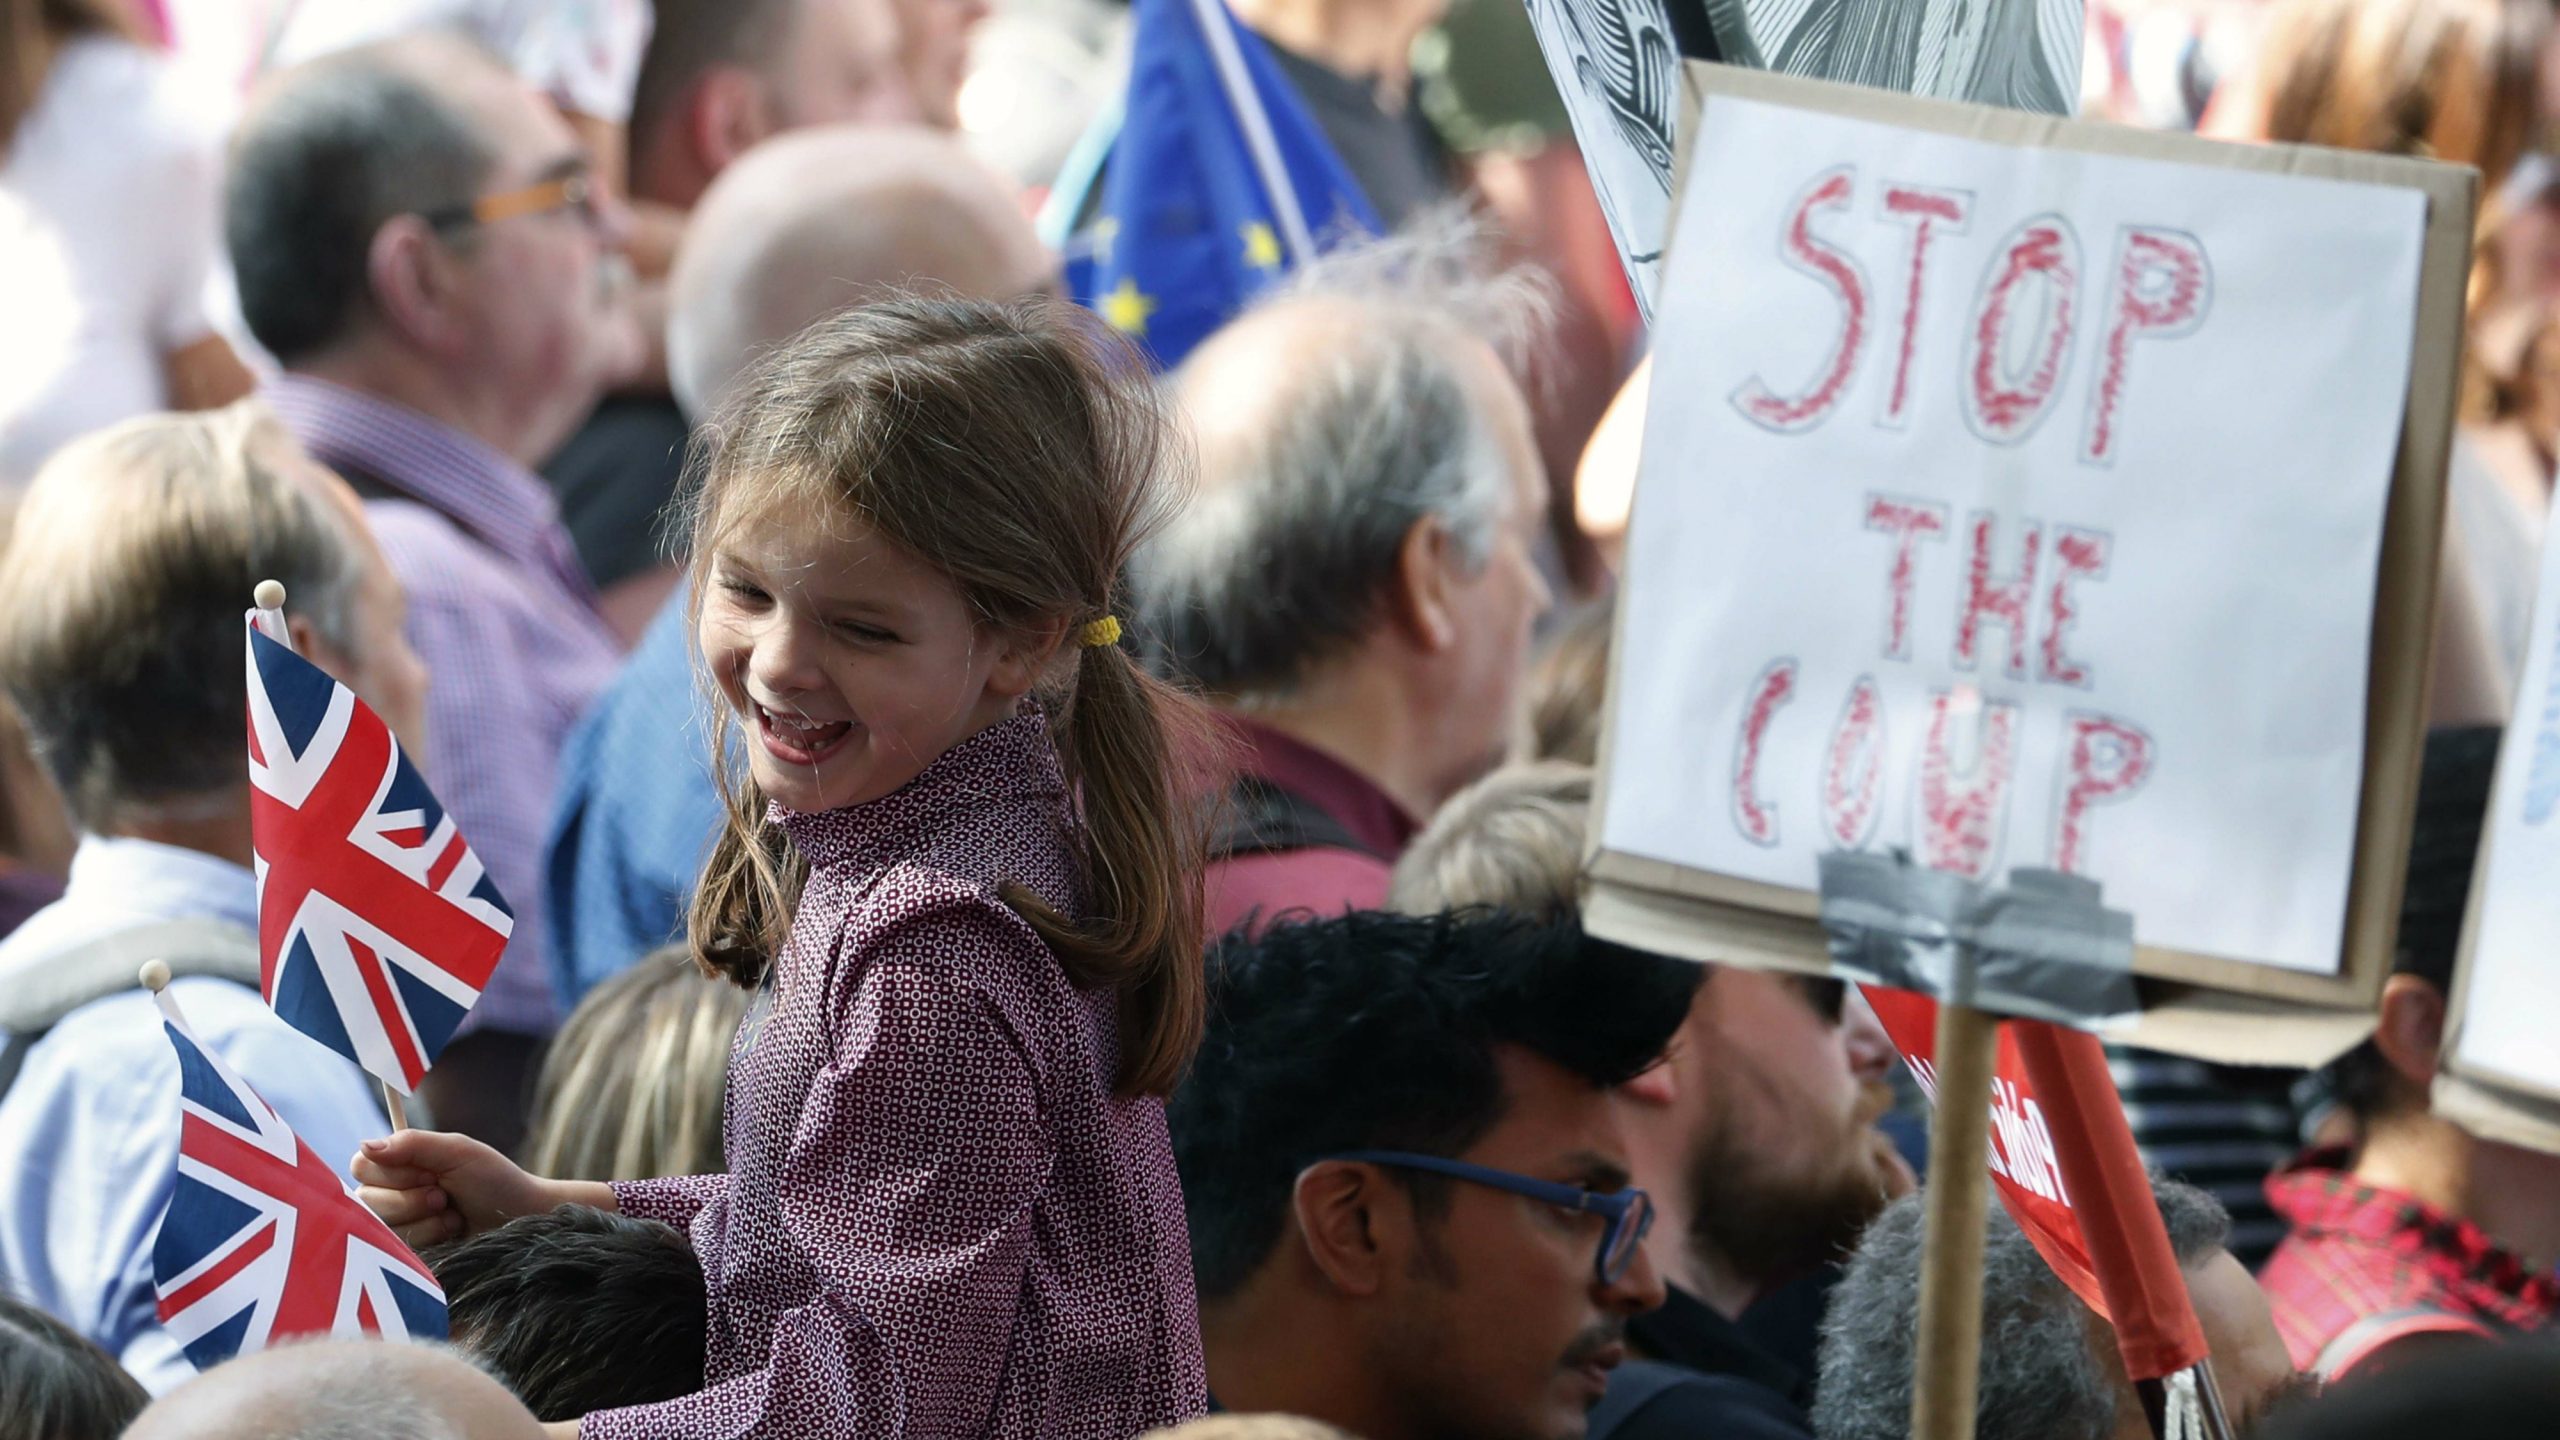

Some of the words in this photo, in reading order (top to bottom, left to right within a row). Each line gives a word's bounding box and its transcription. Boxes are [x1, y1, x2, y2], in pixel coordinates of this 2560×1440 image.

[1729, 162, 2214, 467] STOP
[1863, 491, 2113, 691] THE
[1731, 656, 2155, 882] COUP
